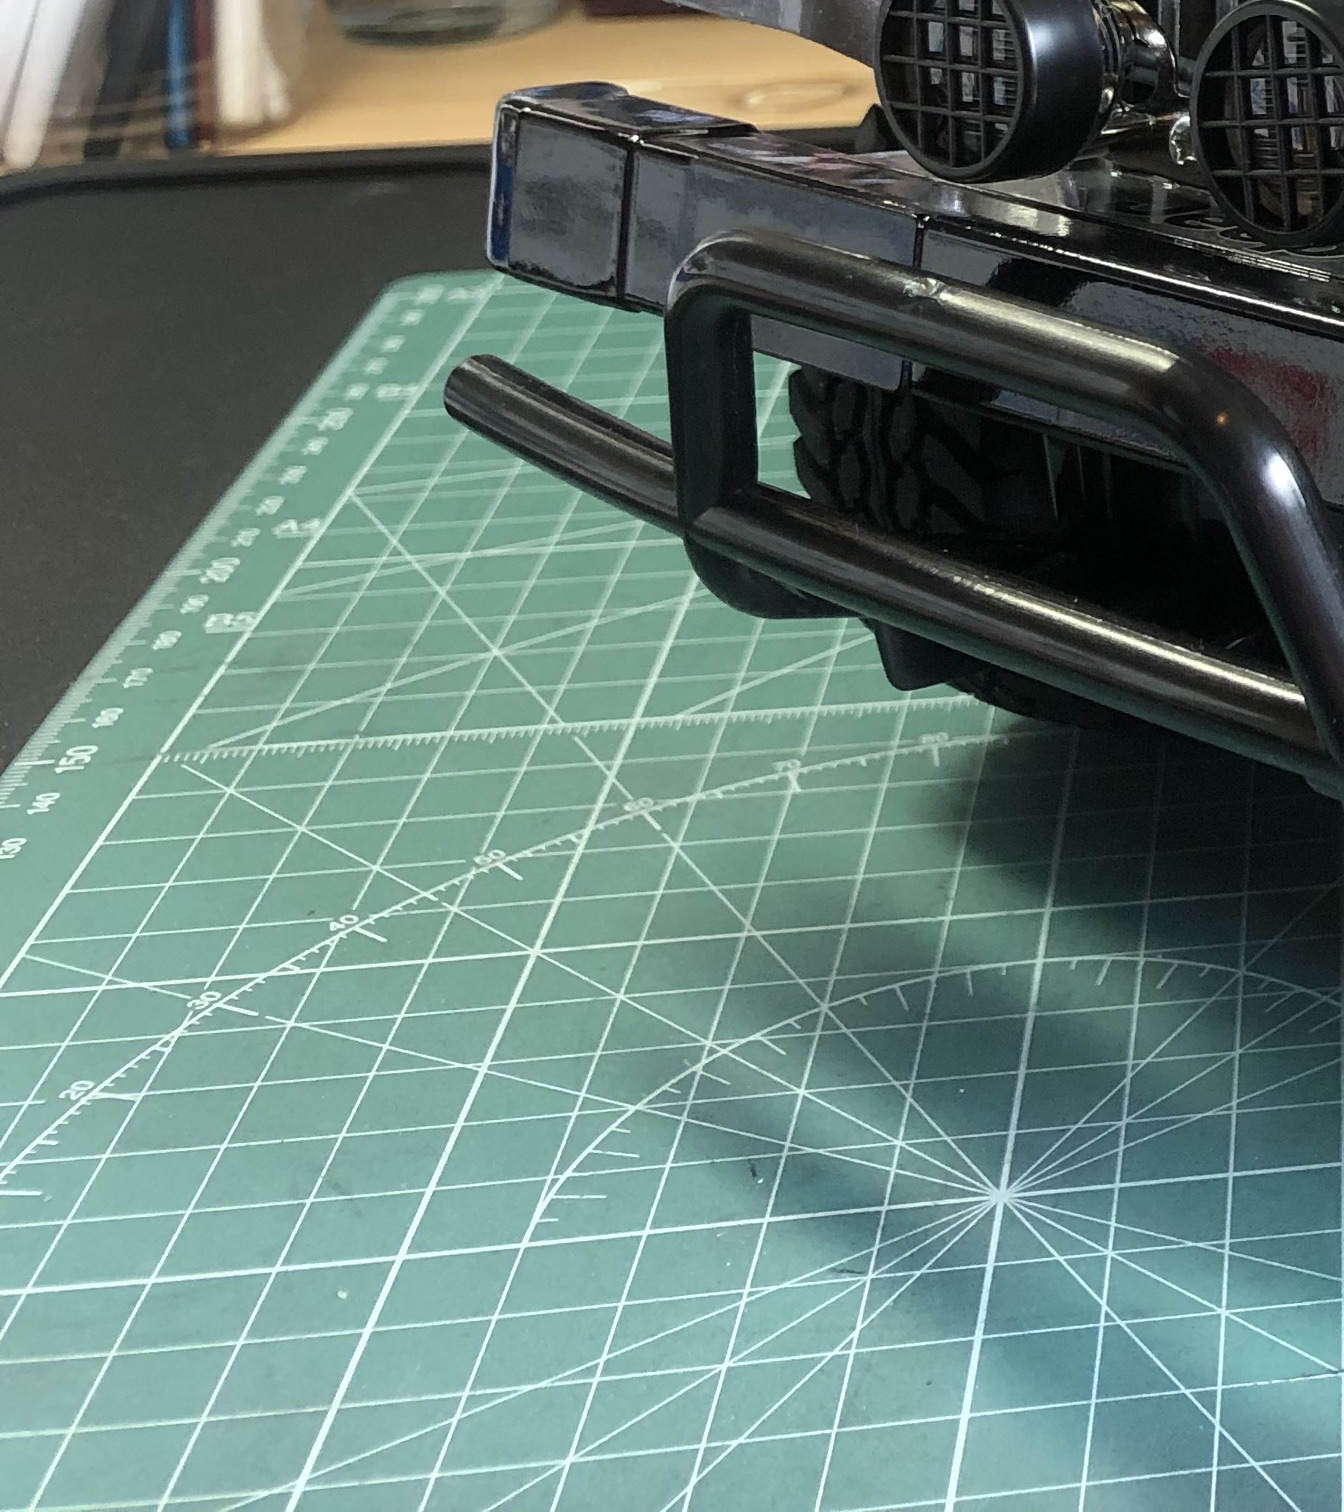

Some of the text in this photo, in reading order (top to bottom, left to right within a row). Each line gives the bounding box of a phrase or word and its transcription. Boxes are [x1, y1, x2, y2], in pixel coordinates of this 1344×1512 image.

[55, 745, 98, 774] 150
[27, 792, 60, 815] 140
[330, 914, 359, 931] 40
[187, 991, 222, 1010] 30
[58, 1080, 95, 1101] 20
